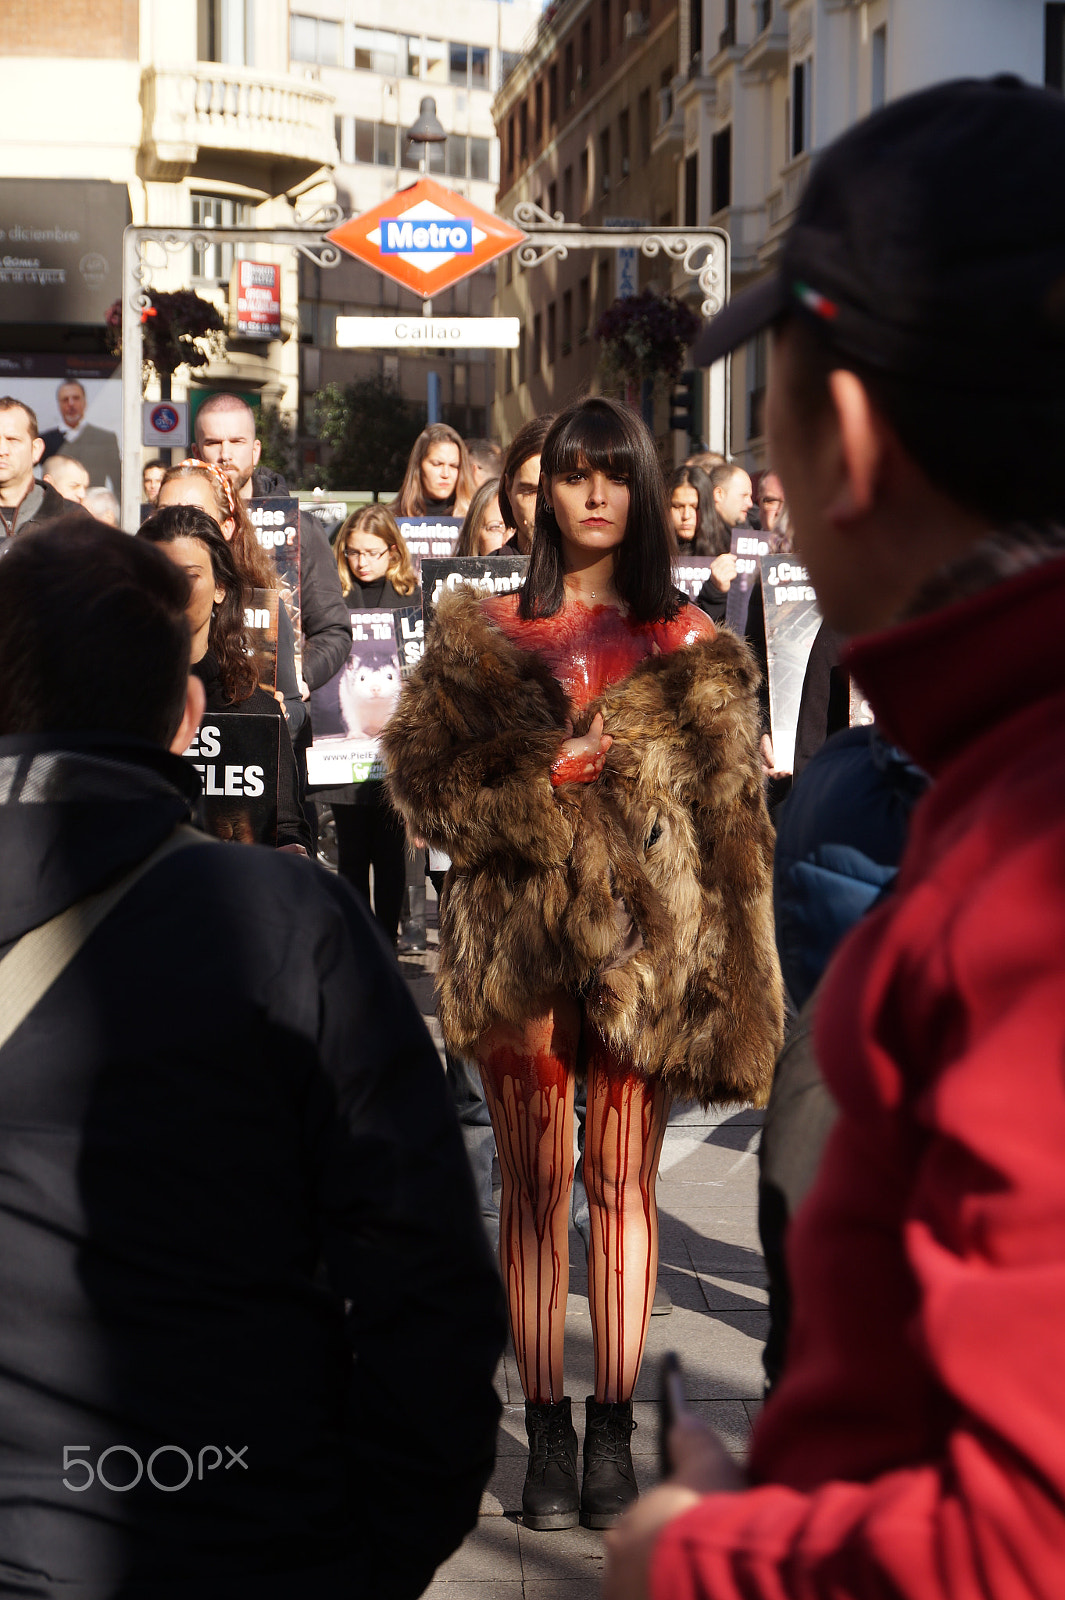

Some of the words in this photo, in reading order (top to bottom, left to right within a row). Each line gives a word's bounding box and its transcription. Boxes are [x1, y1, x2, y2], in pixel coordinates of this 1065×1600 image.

[386, 222, 468, 249] Metro
[394, 323, 462, 339] Callao
[371, 623, 392, 640] Tú
